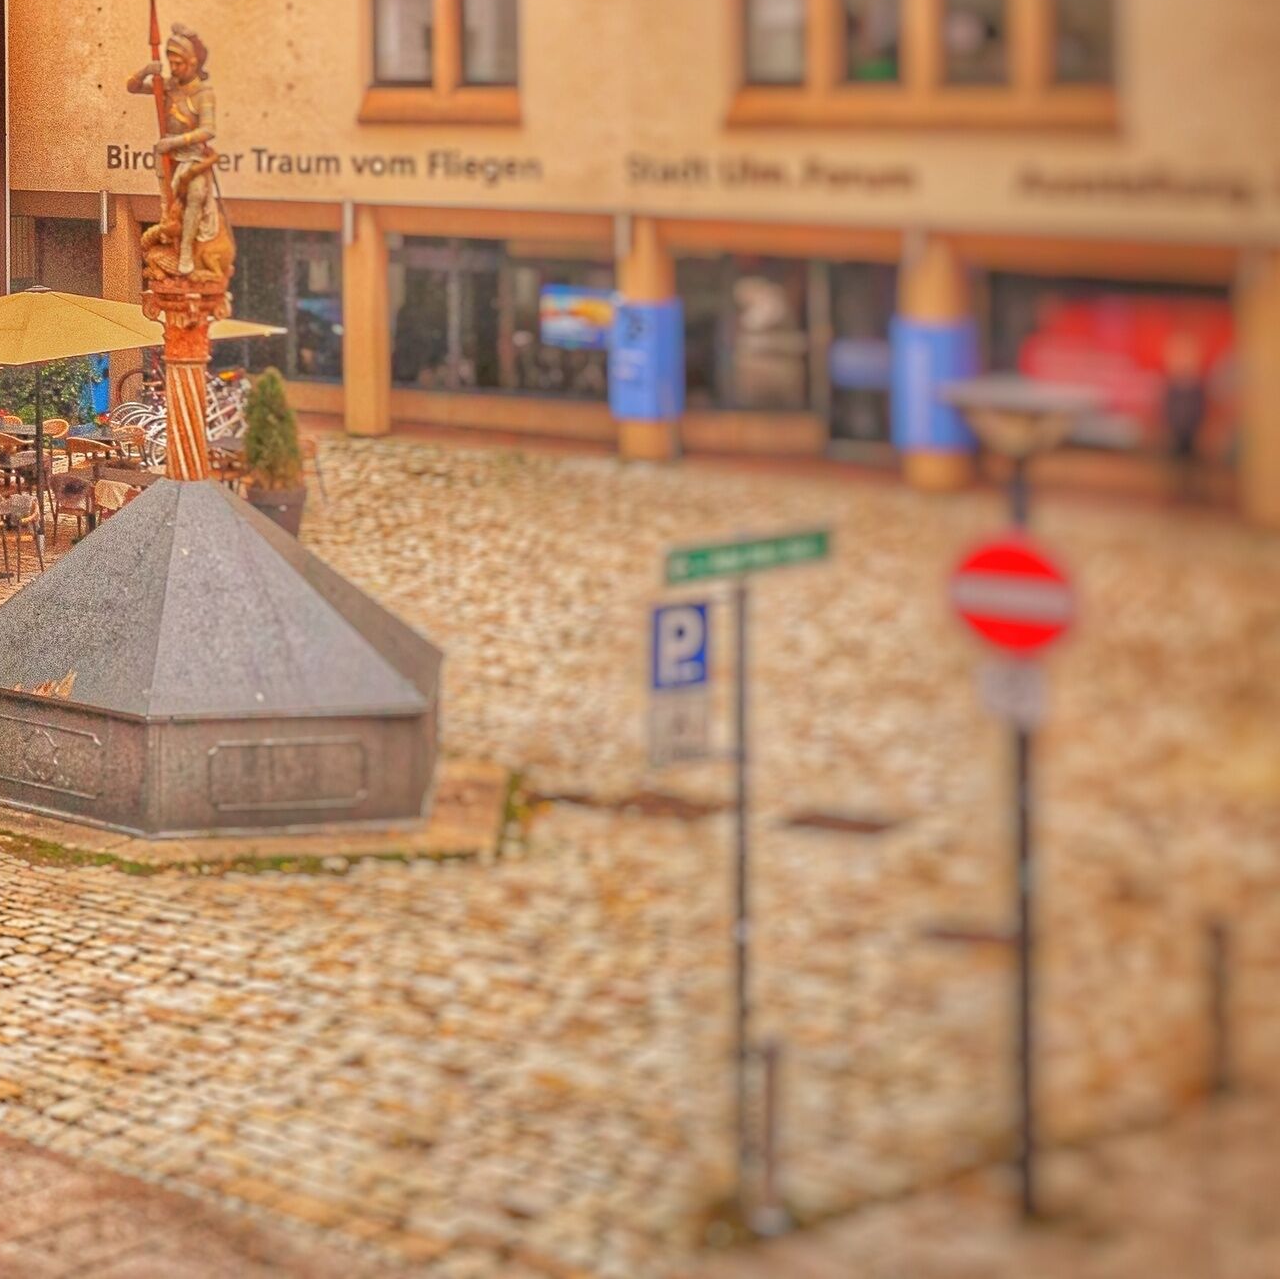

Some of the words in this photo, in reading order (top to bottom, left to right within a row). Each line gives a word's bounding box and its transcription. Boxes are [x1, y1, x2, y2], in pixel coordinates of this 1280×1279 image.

[106, 144, 158, 170] Bird
[216, 153, 244, 172] er
[251, 148, 340, 174] Traum
[351, 155, 416, 176] vom
[427, 149, 544, 187] Fliegen
[658, 607, 704, 682] P
